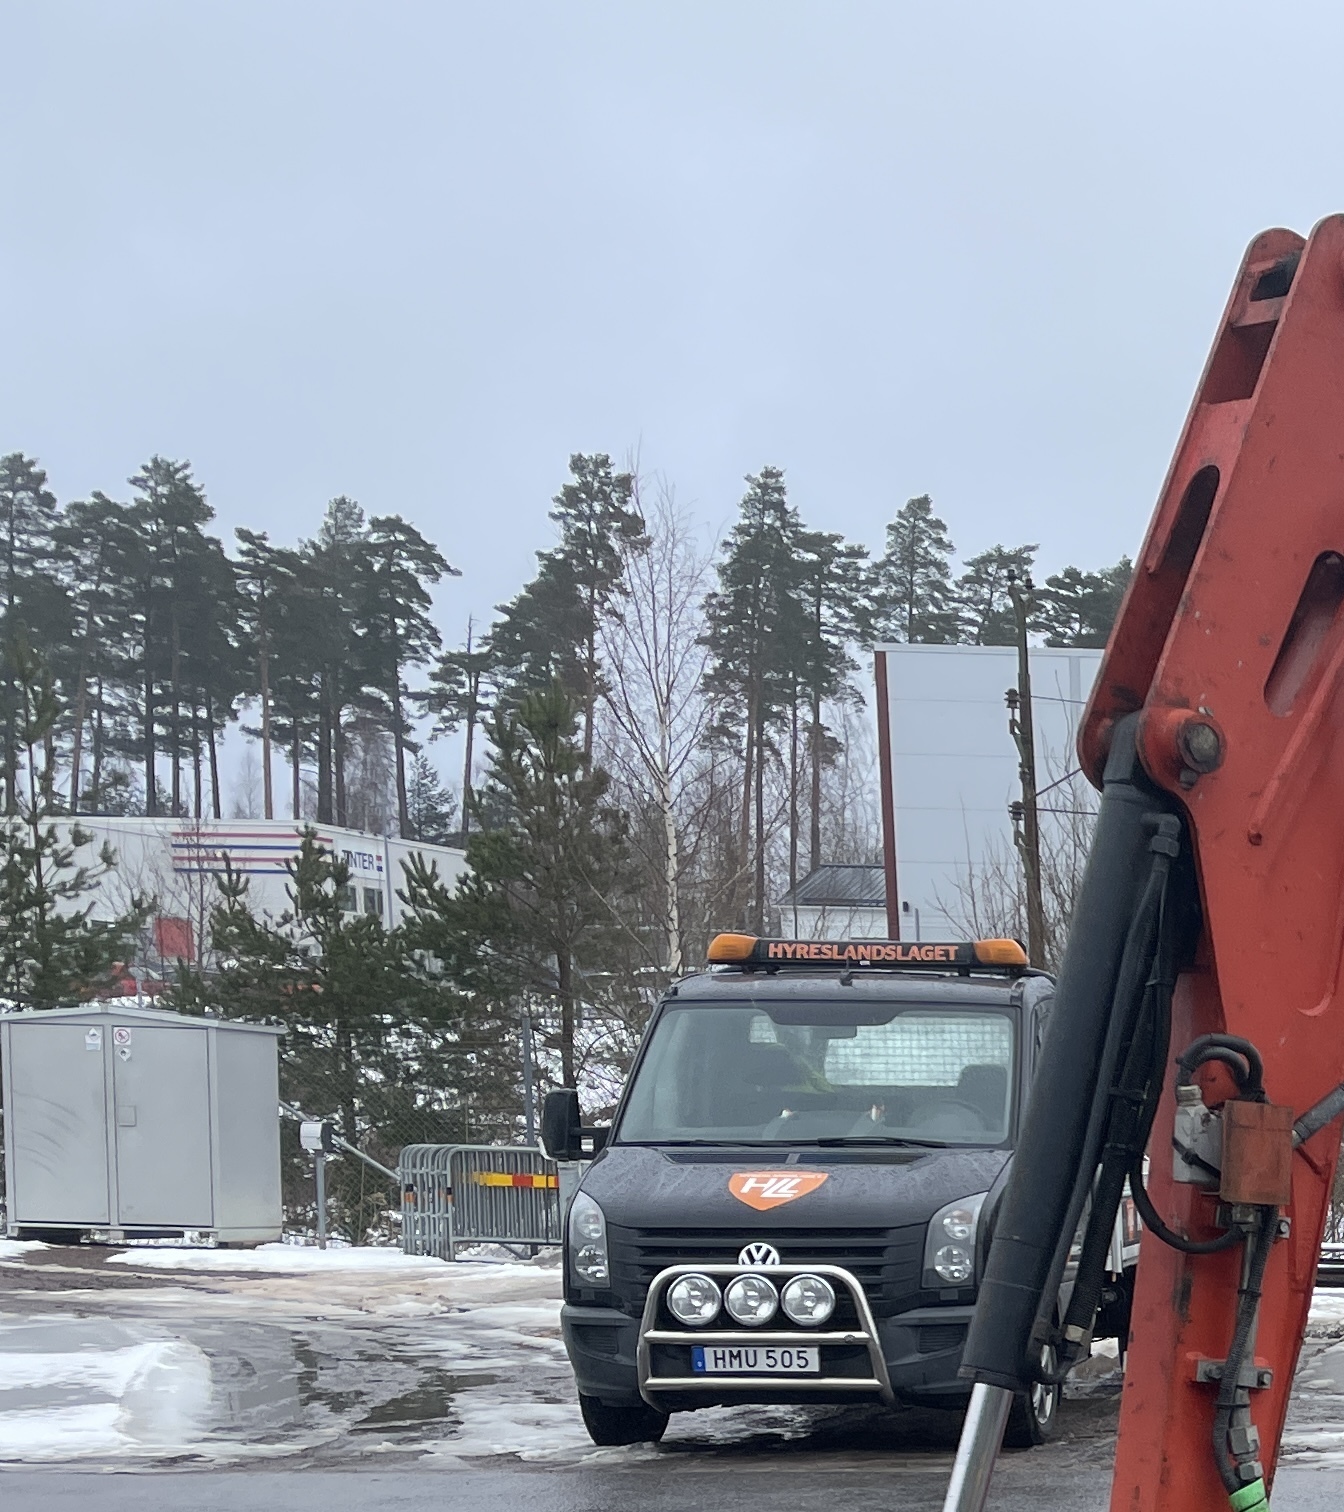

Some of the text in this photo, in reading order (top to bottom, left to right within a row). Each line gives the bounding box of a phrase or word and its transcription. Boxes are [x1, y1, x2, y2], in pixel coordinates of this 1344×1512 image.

[768, 943, 959, 962] HYRESLANDSLAGET
[713, 1349, 809, 1369] HMU 505
